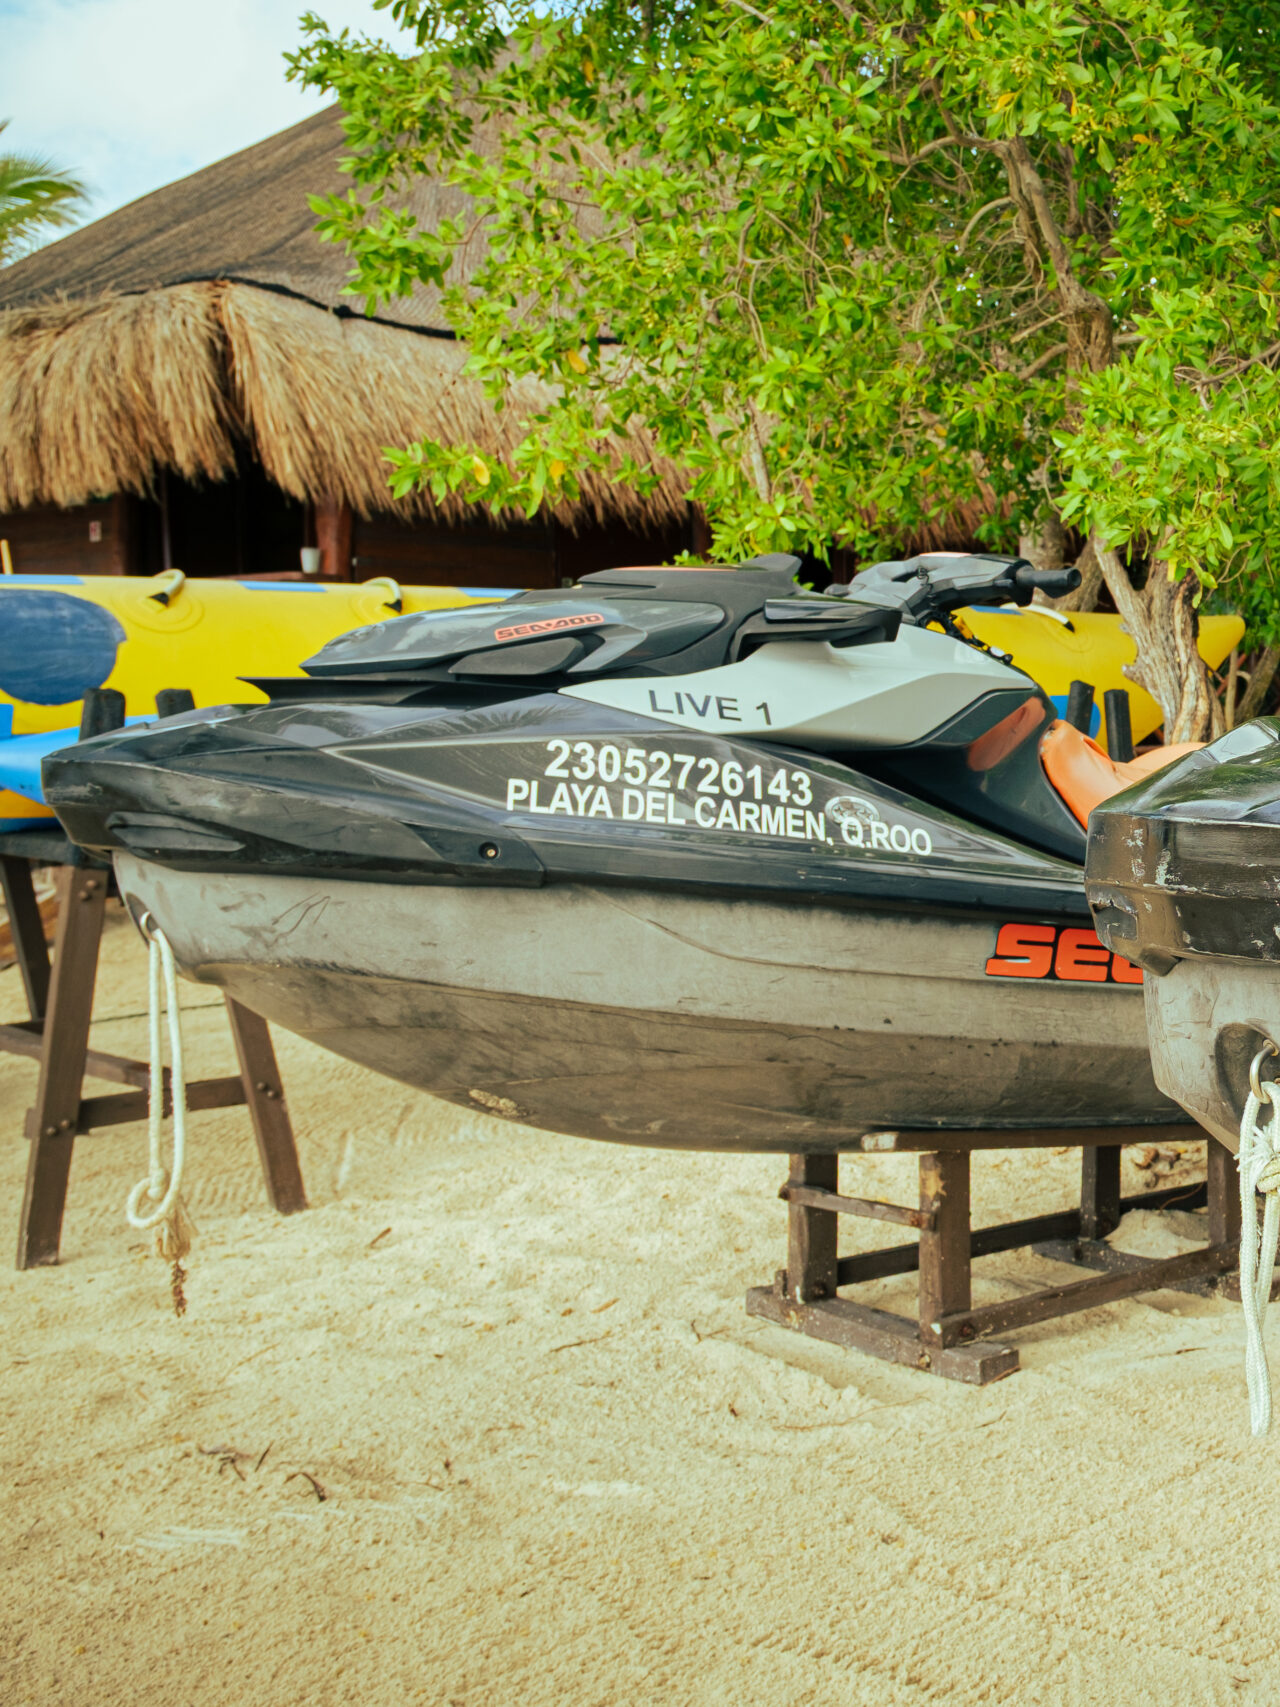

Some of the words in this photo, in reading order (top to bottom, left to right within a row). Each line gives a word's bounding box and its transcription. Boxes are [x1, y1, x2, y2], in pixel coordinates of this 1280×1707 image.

[648, 690, 742, 722] LIVE
[756, 702, 772, 726] 1
[545, 738, 813, 807] 23052726143
[506, 778, 614, 820] PLAYA
[622, 788, 687, 826] DEL
[694, 796, 834, 847] CARMEN,
[840, 816, 932, 857] Q.ROO
